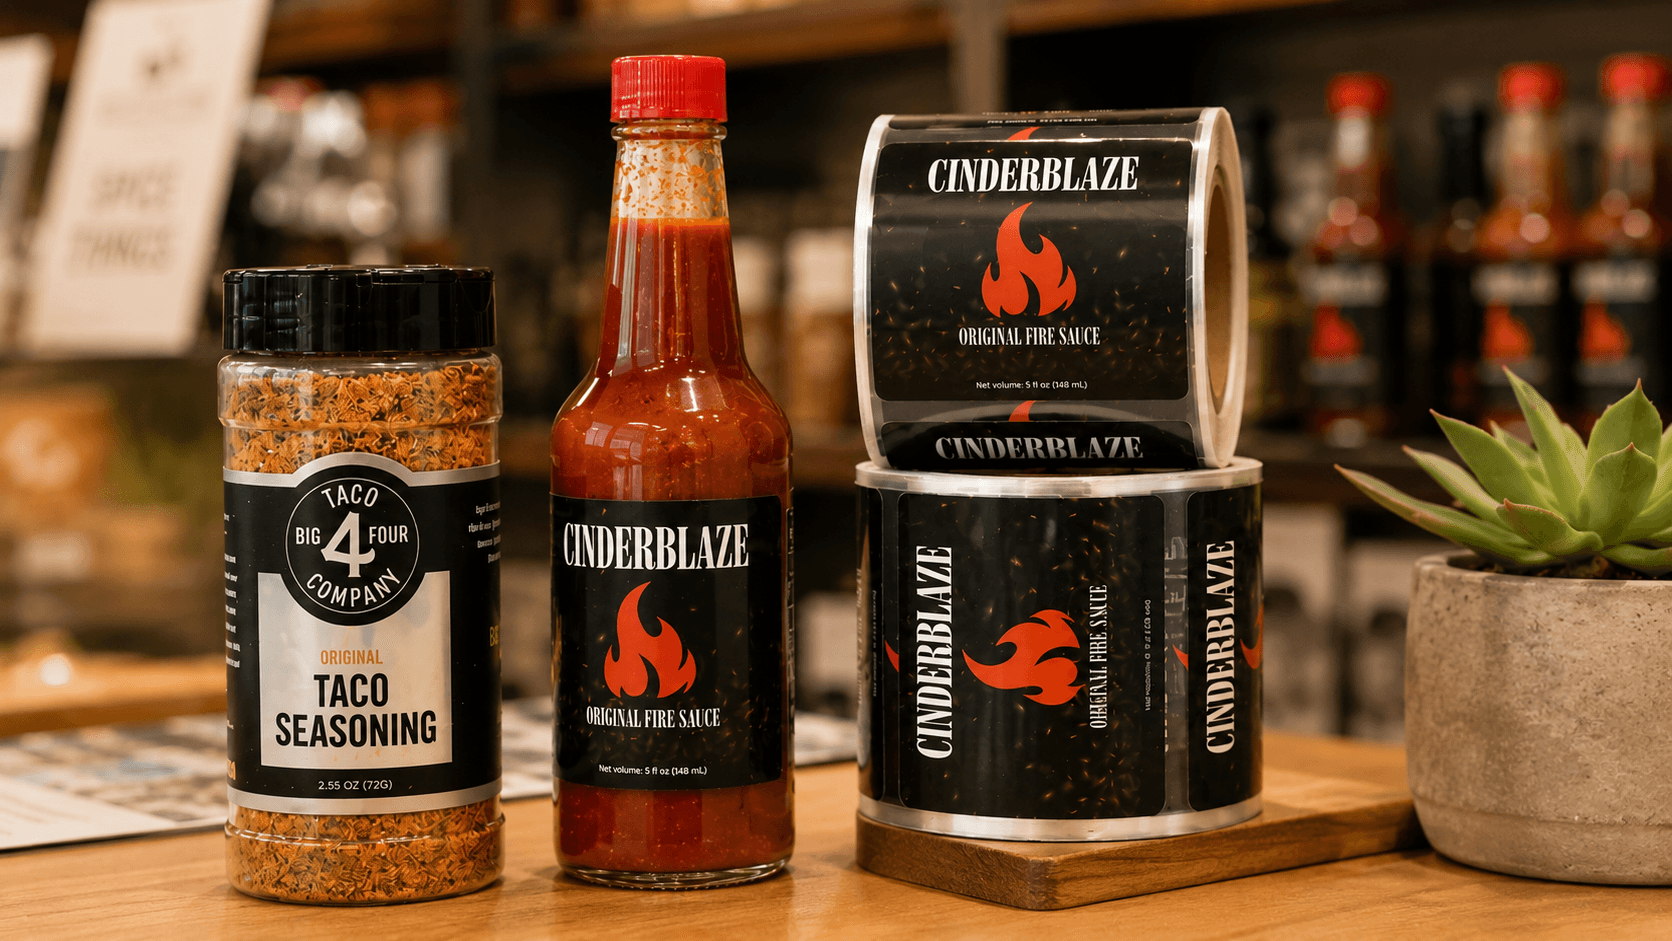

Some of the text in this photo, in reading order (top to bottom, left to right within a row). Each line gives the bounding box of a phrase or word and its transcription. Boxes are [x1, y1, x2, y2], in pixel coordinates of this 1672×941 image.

[928, 156, 1140, 193] CINDERBLAZE
[958, 327, 1101, 346] ORIGINAL FIRE SAUCE
[976, 381, 990, 389] Net
[992, 381, 1024, 389] volume:
[1052, 381, 1070, 390] (148
[1071, 381, 1088, 390] mL)
[935, 436, 1144, 460] CINDERBLAZE
[321, 484, 379, 509] TACO
[295, 511, 409, 578] BIG 4 FOUR
[563, 522, 749, 571] CINDERBLAZE
[306, 567, 401, 607] COMPANY
[320, 649, 383, 665] ORIGINAL
[915, 545, 953, 759] CINDERBLAZE
[1206, 540, 1235, 754] CINDERBLAZE
[313, 672, 389, 708] TACO
[275, 709, 437, 748] SEASONING
[586, 706, 721, 729] ORIGINAL FIRE SAUCE
[318, 779, 393, 791] 2.55 OZ (72G)
[598, 764, 612, 773] Net
[613, 765, 643, 775] volume:
[671, 766, 689, 776] (148
[691, 766, 708, 776] mL)
